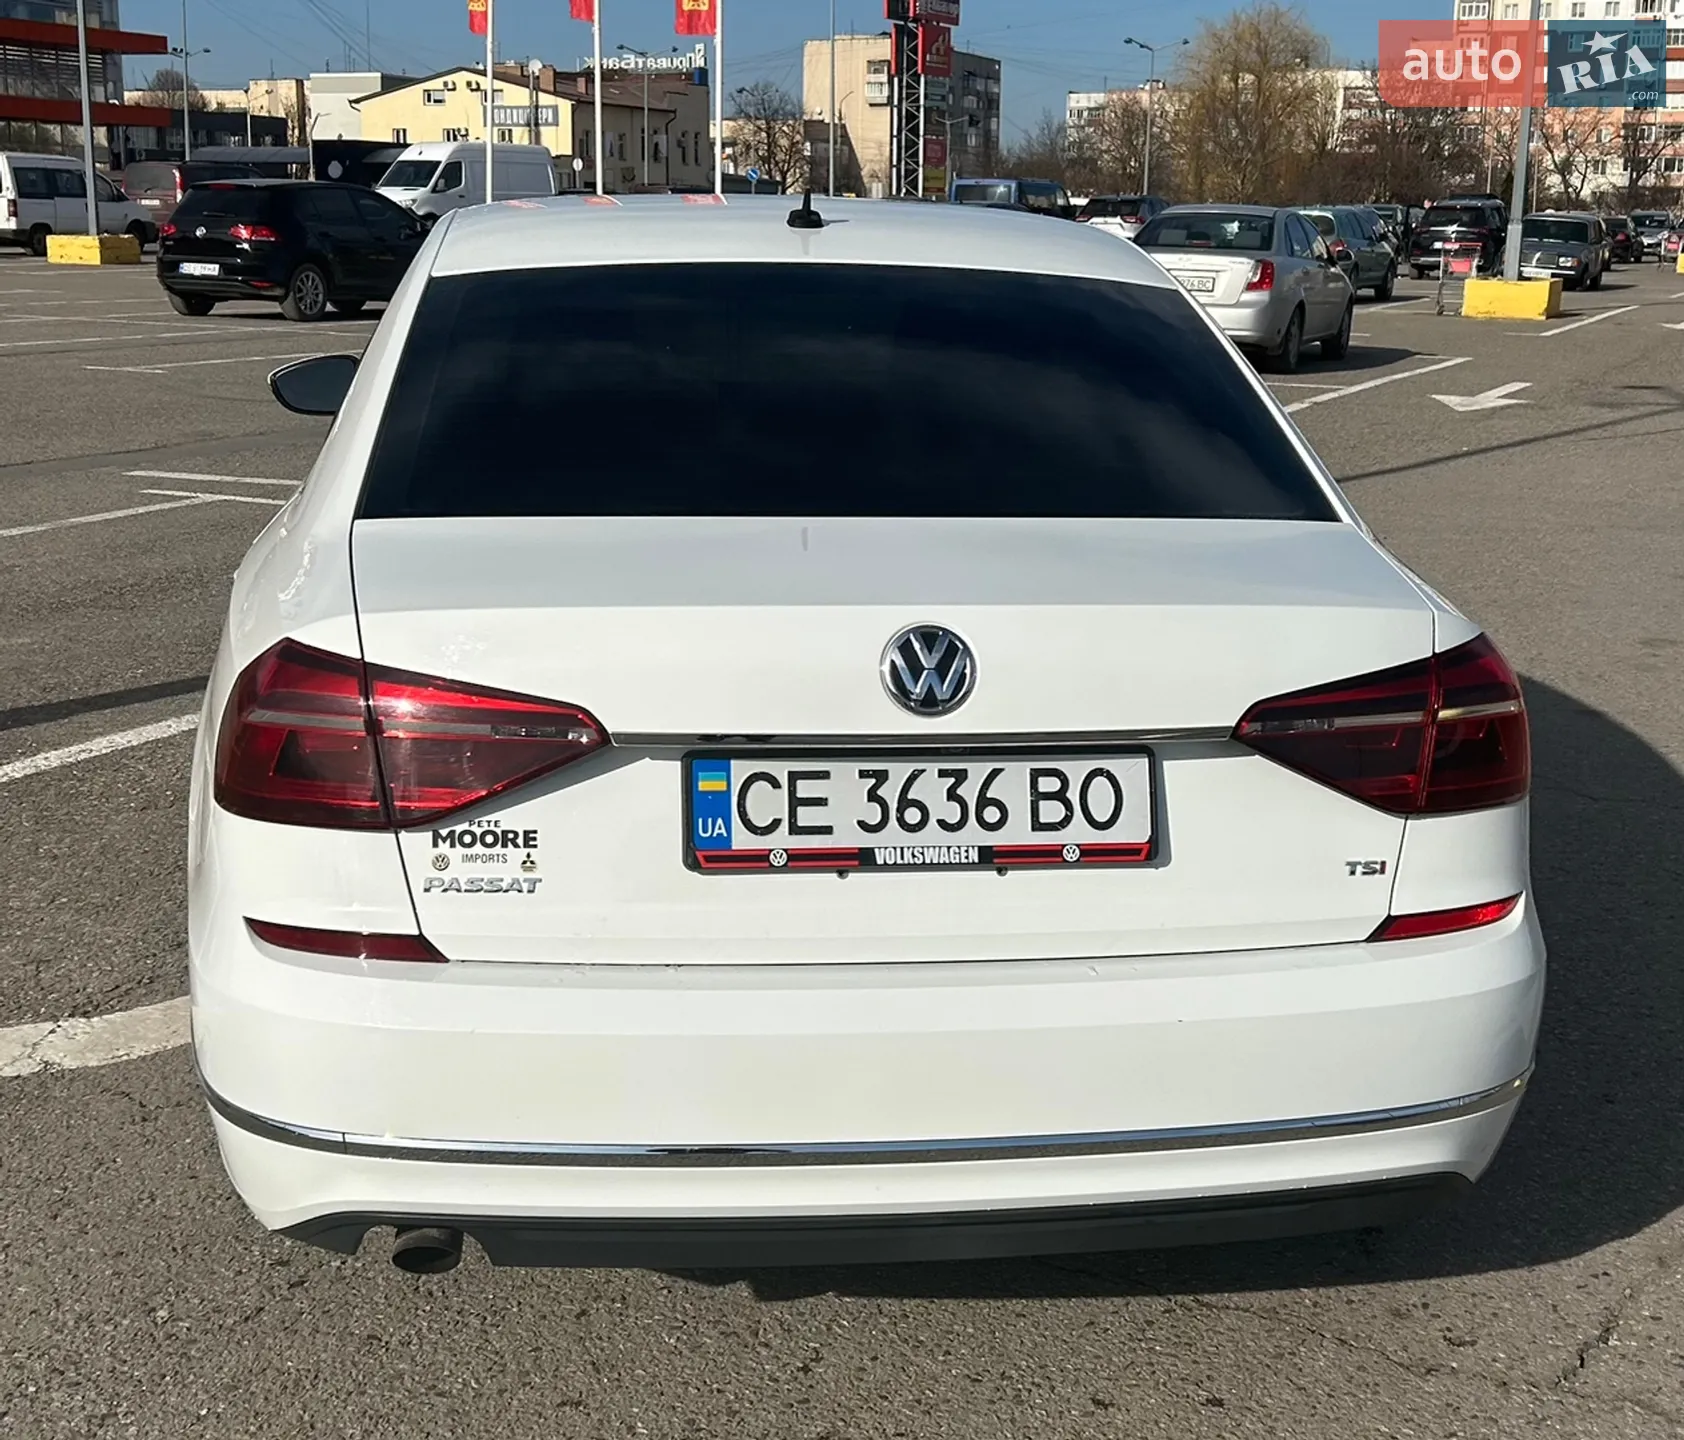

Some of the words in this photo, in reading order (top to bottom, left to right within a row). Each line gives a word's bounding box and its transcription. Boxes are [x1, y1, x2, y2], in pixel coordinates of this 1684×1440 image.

[736, 770, 834, 836] CE
[856, 767, 1009, 834] 3636
[1028, 767, 1124, 832] BO
[468, 819, 502, 828] PETE
[698, 817, 728, 837] UA
[432, 829, 538, 849] MOORE
[461, 853, 508, 864] IMPORTS
[874, 846, 979, 865] VOLKSWAGEN
[1344, 860, 1387, 877] TSI
[423, 876, 543, 894] PASSAT
